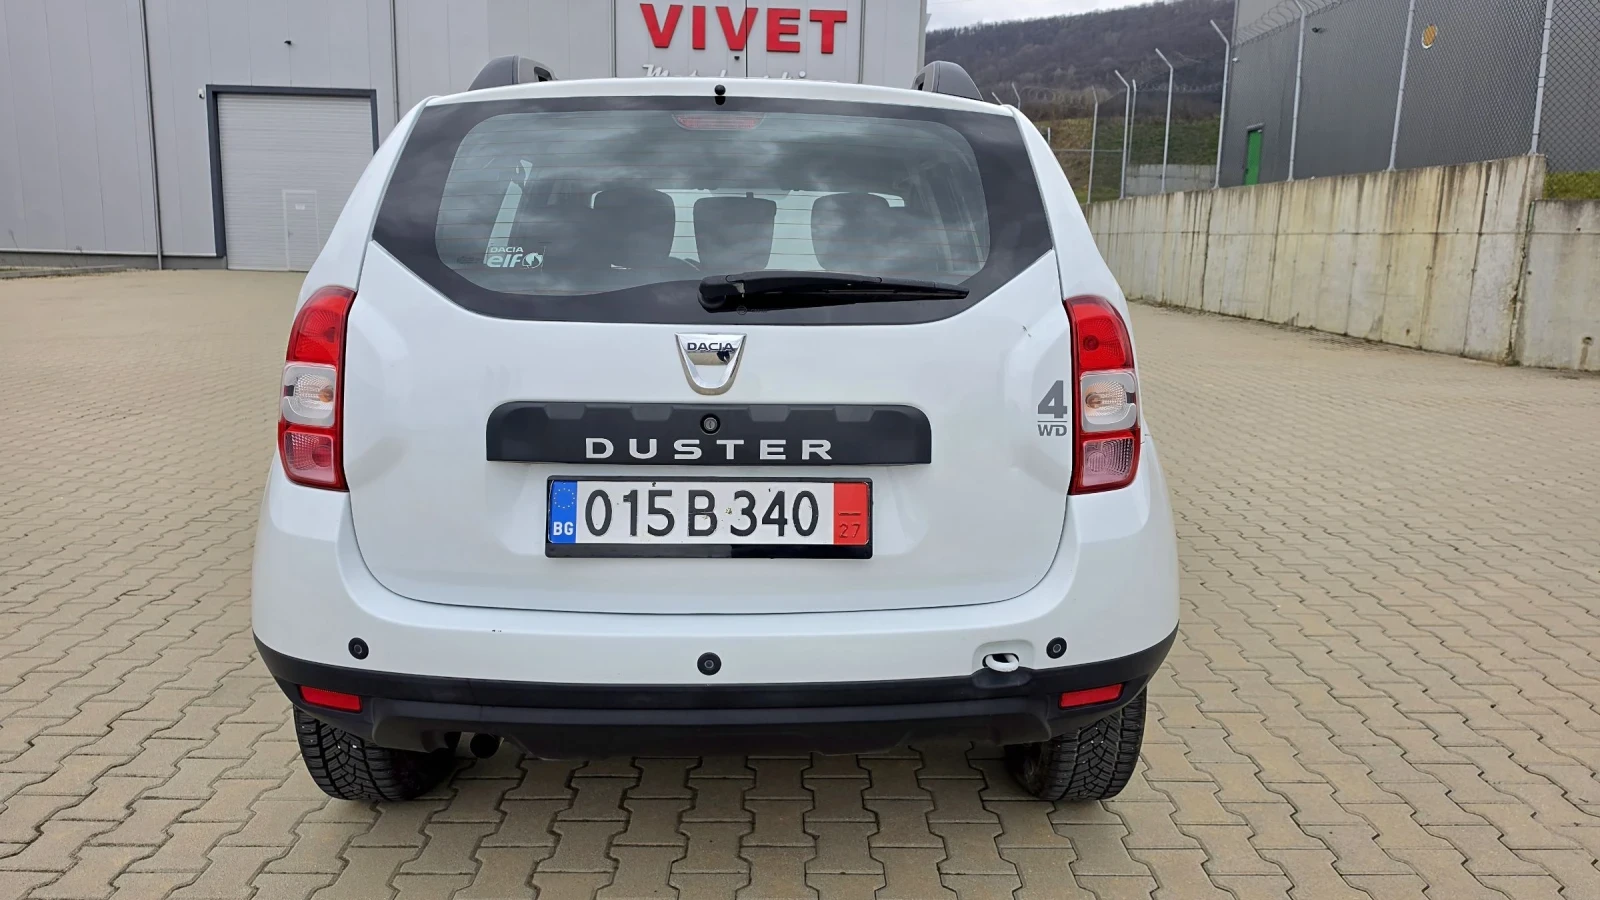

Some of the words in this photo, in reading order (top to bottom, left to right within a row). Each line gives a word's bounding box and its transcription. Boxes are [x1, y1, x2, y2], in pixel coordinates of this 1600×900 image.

[640, 3, 847, 54] VIVET
[486, 253, 523, 268] elf
[687, 342, 734, 351] DACIA
[1037, 379, 1068, 419] 4
[1037, 424, 1068, 437] WD
[585, 437, 832, 460] DUSTER
[552, 521, 574, 536] BG
[838, 523, 861, 539] 27
